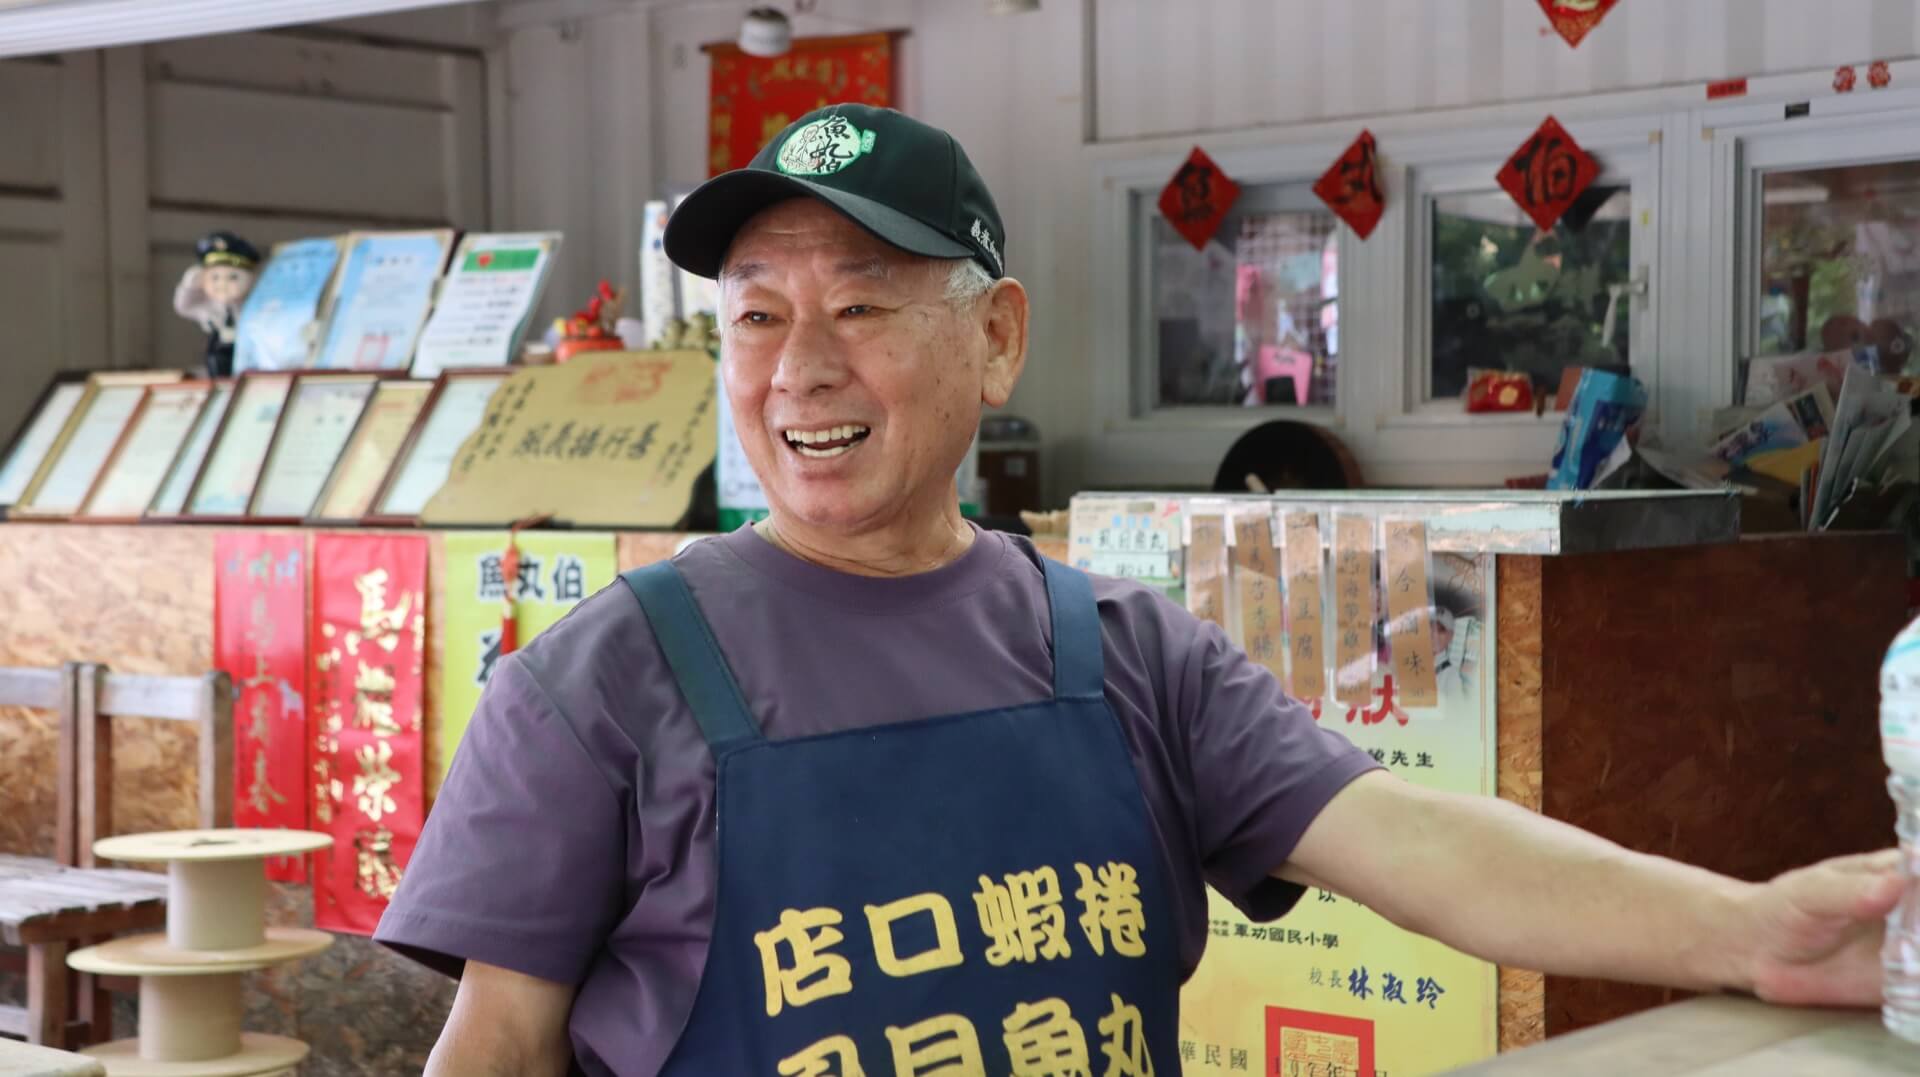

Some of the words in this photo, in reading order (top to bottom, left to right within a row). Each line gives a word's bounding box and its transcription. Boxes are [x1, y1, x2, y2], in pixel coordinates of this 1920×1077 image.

[809, 114, 854, 174] 魚丸伯
[754, 861, 1147, 1017] 店口蝦捲
[1234, 923, 1339, 949] 軍功國民小學
[1309, 967, 1343, 989] 校長
